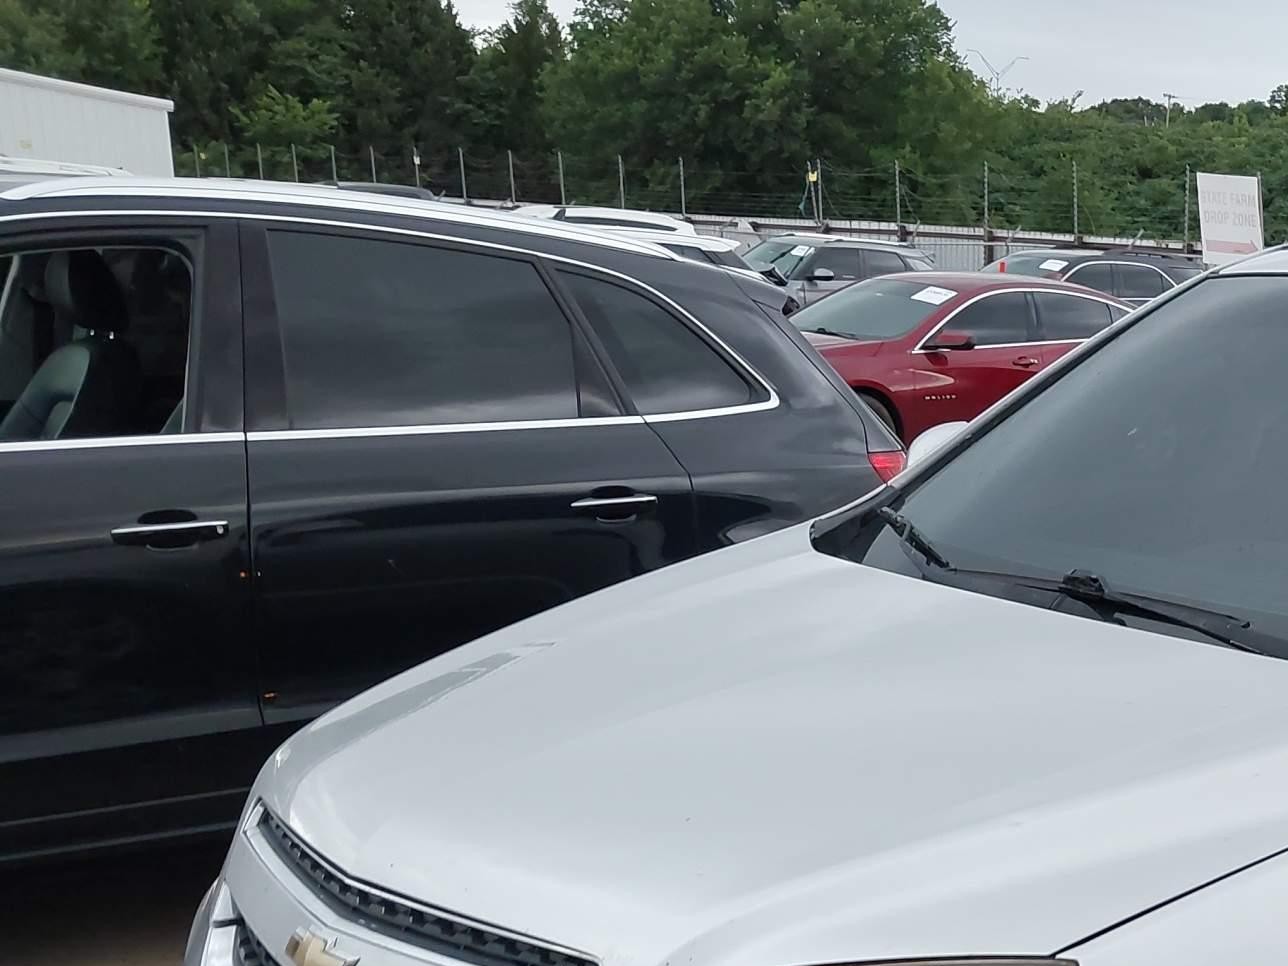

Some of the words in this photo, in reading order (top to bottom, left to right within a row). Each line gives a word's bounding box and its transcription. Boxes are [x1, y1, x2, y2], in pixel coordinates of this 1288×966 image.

[1201, 190, 1227, 206] STATE
[1230, 192, 1256, 208] FARM
[1203, 210, 1229, 224] DROP
[1232, 213, 1258, 228] ZONE
